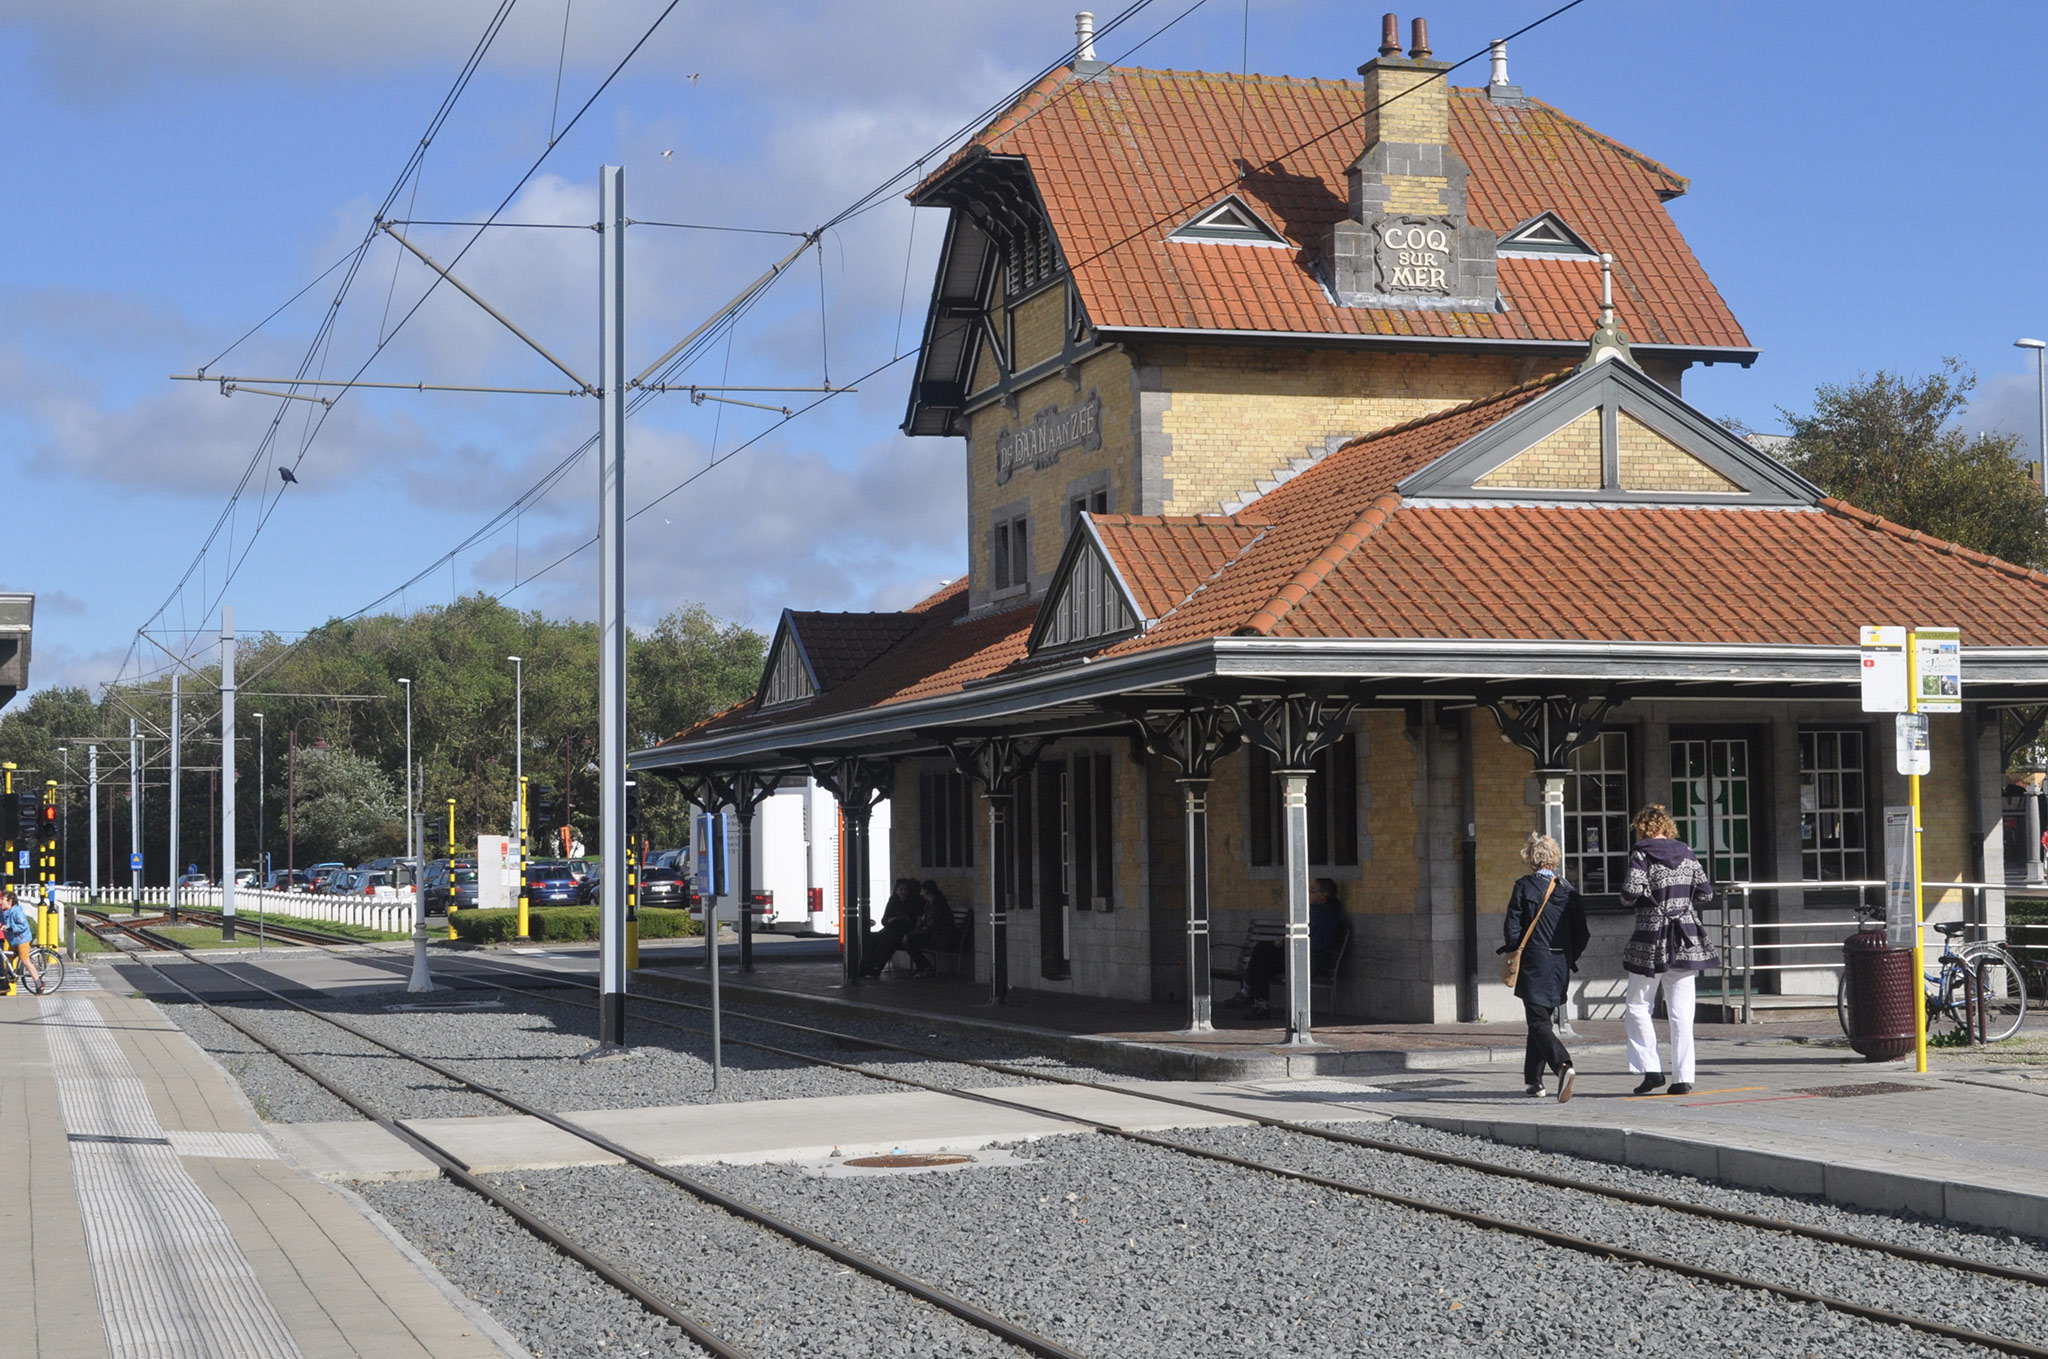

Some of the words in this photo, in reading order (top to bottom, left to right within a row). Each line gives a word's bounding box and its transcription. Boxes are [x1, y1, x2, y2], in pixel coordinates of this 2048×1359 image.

[1384, 228, 1449, 254] COQ
[1399, 251, 1438, 266] SUR
[1390, 267, 1448, 288] MER
[1001, 445, 1013, 469] DE
[1070, 404, 1094, 440] ZEE
